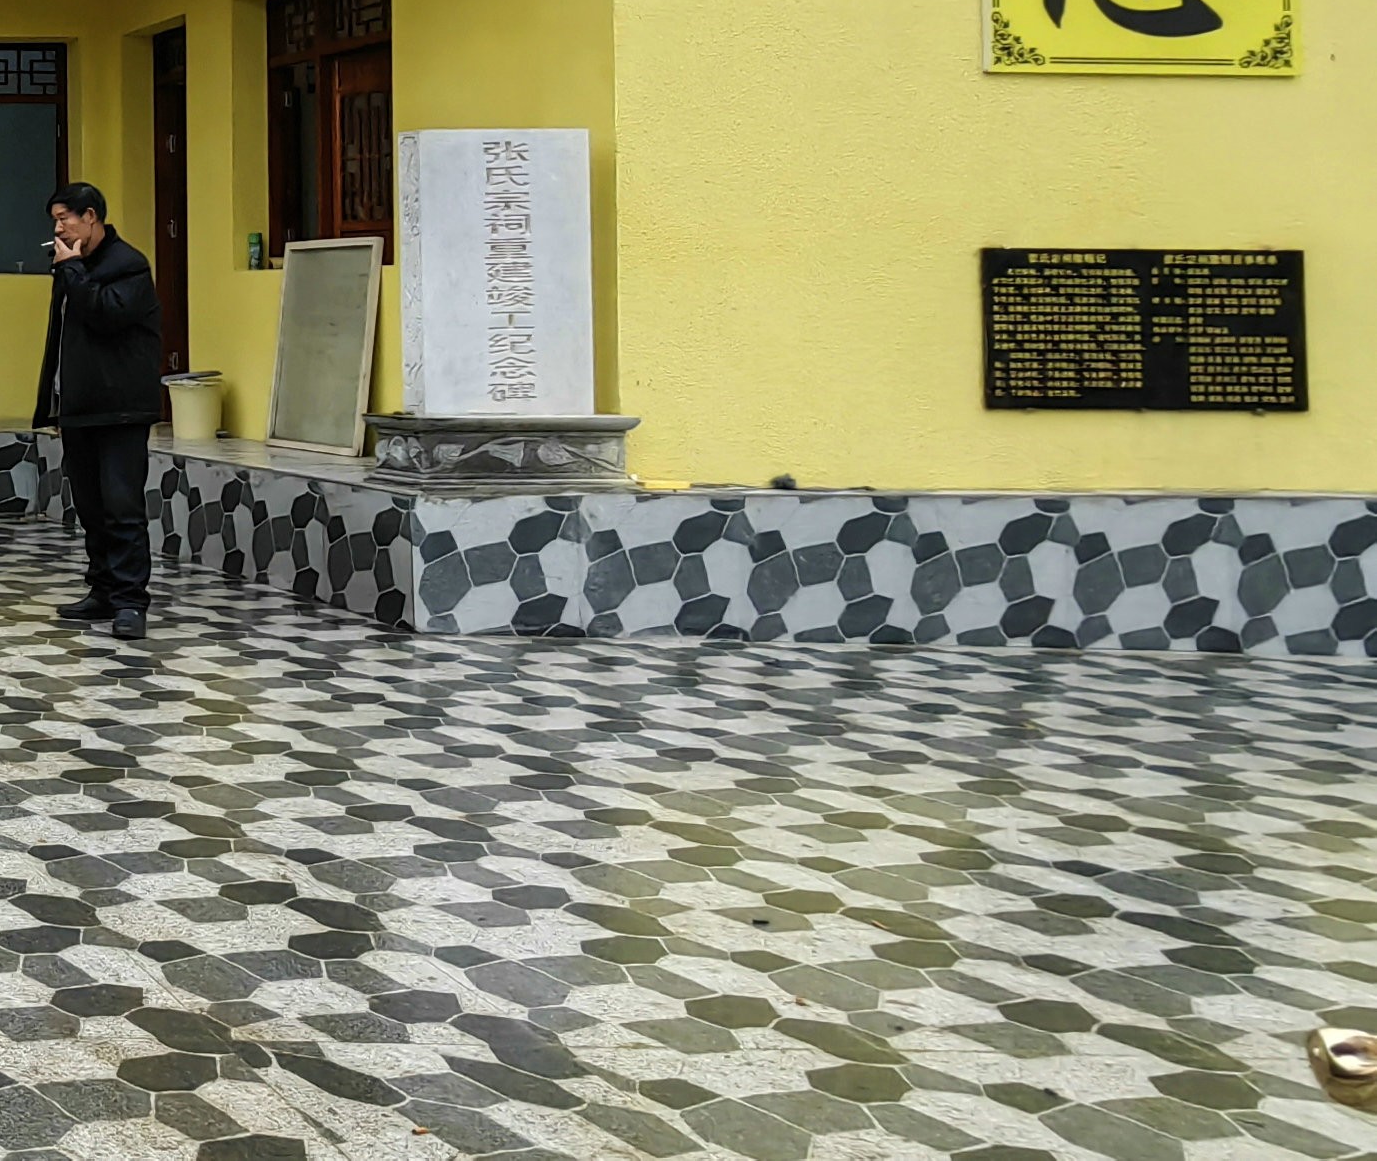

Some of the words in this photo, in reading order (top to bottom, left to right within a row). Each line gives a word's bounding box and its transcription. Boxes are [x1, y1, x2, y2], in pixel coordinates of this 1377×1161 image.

[482, 140, 538, 402] 张氏宗祠重建竣工纪念碑
